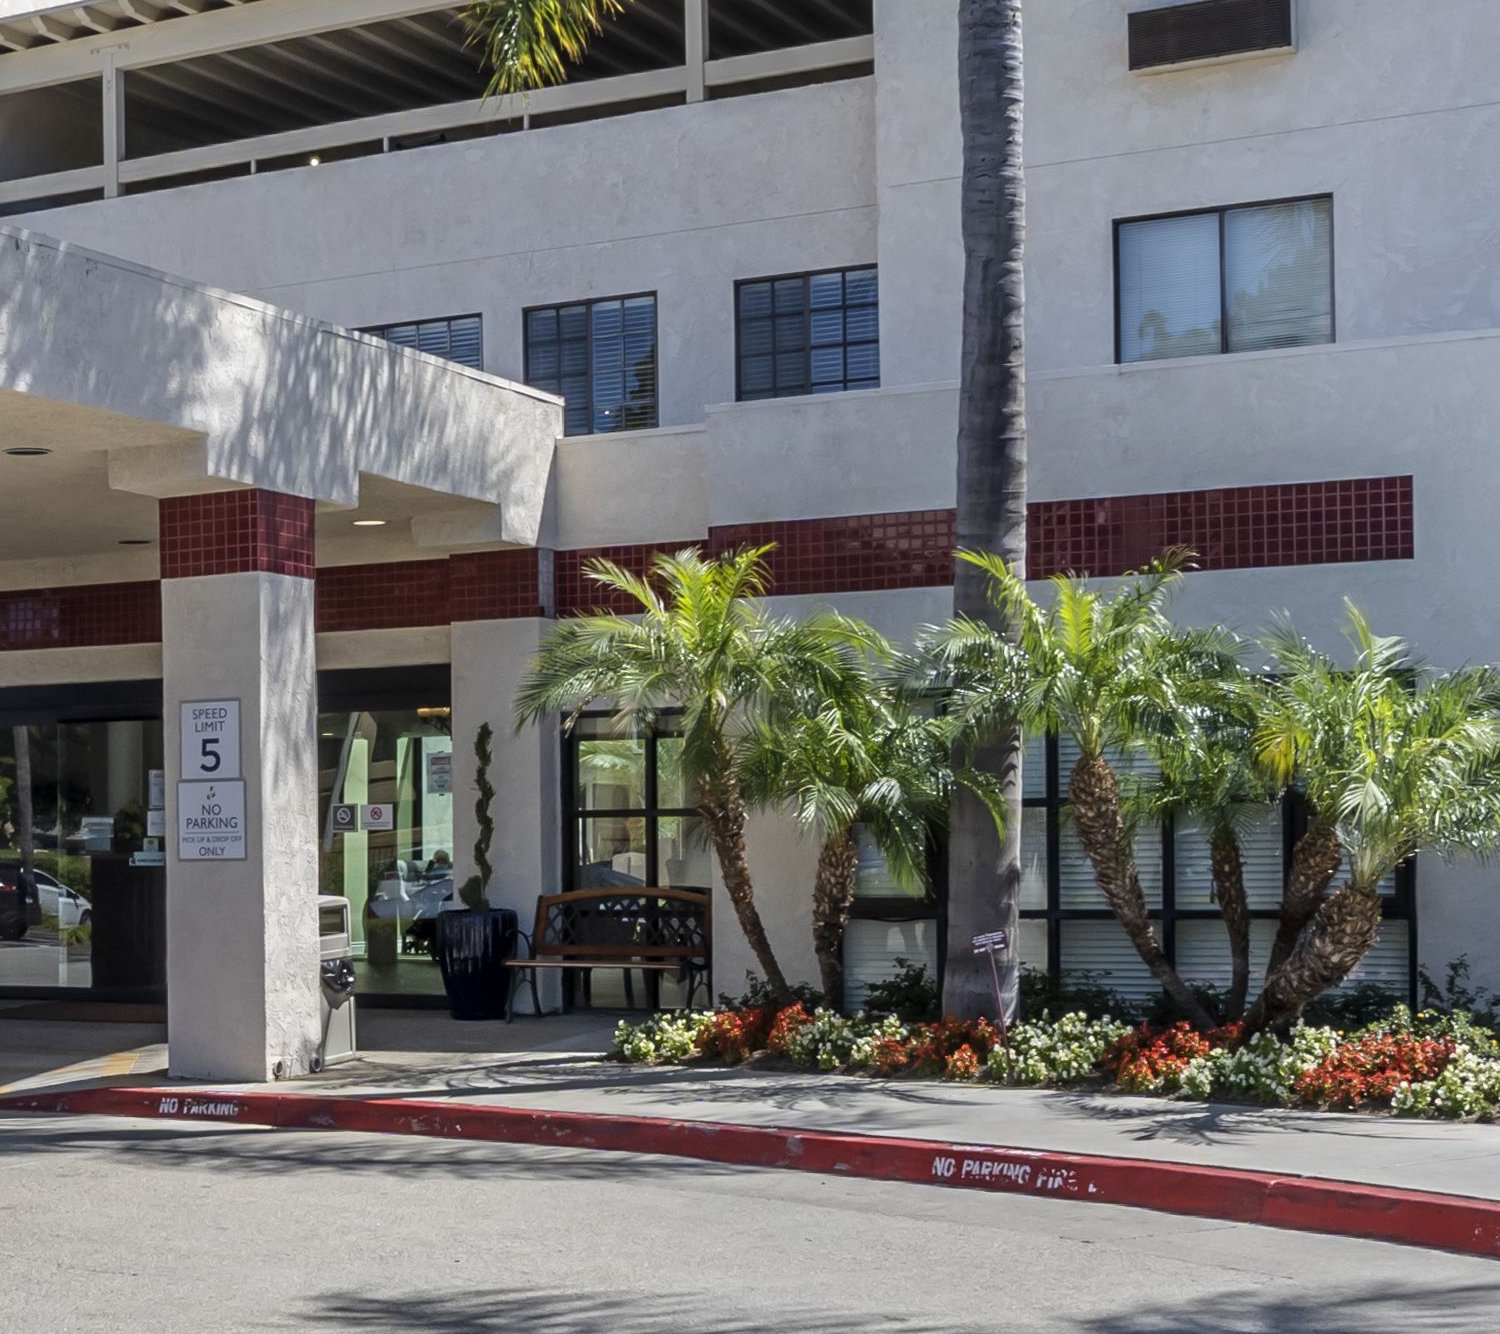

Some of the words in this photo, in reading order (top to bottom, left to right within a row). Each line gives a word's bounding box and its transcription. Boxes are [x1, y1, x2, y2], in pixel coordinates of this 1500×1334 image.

[192, 707, 228, 720] SPEED
[195, 720, 225, 732] LIMIT
[200, 738, 221, 773] 5
[201, 803, 222, 816] NO
[186, 816, 238, 829] PARKING
[212, 835, 229, 843] DROP
[198, 846, 225, 857] ONLY
[159, 1096, 179, 1114] NO
[183, 1098, 239, 1116] PARKING
[931, 1156, 957, 1177] NO
[961, 1158, 1032, 1185] PARKING
